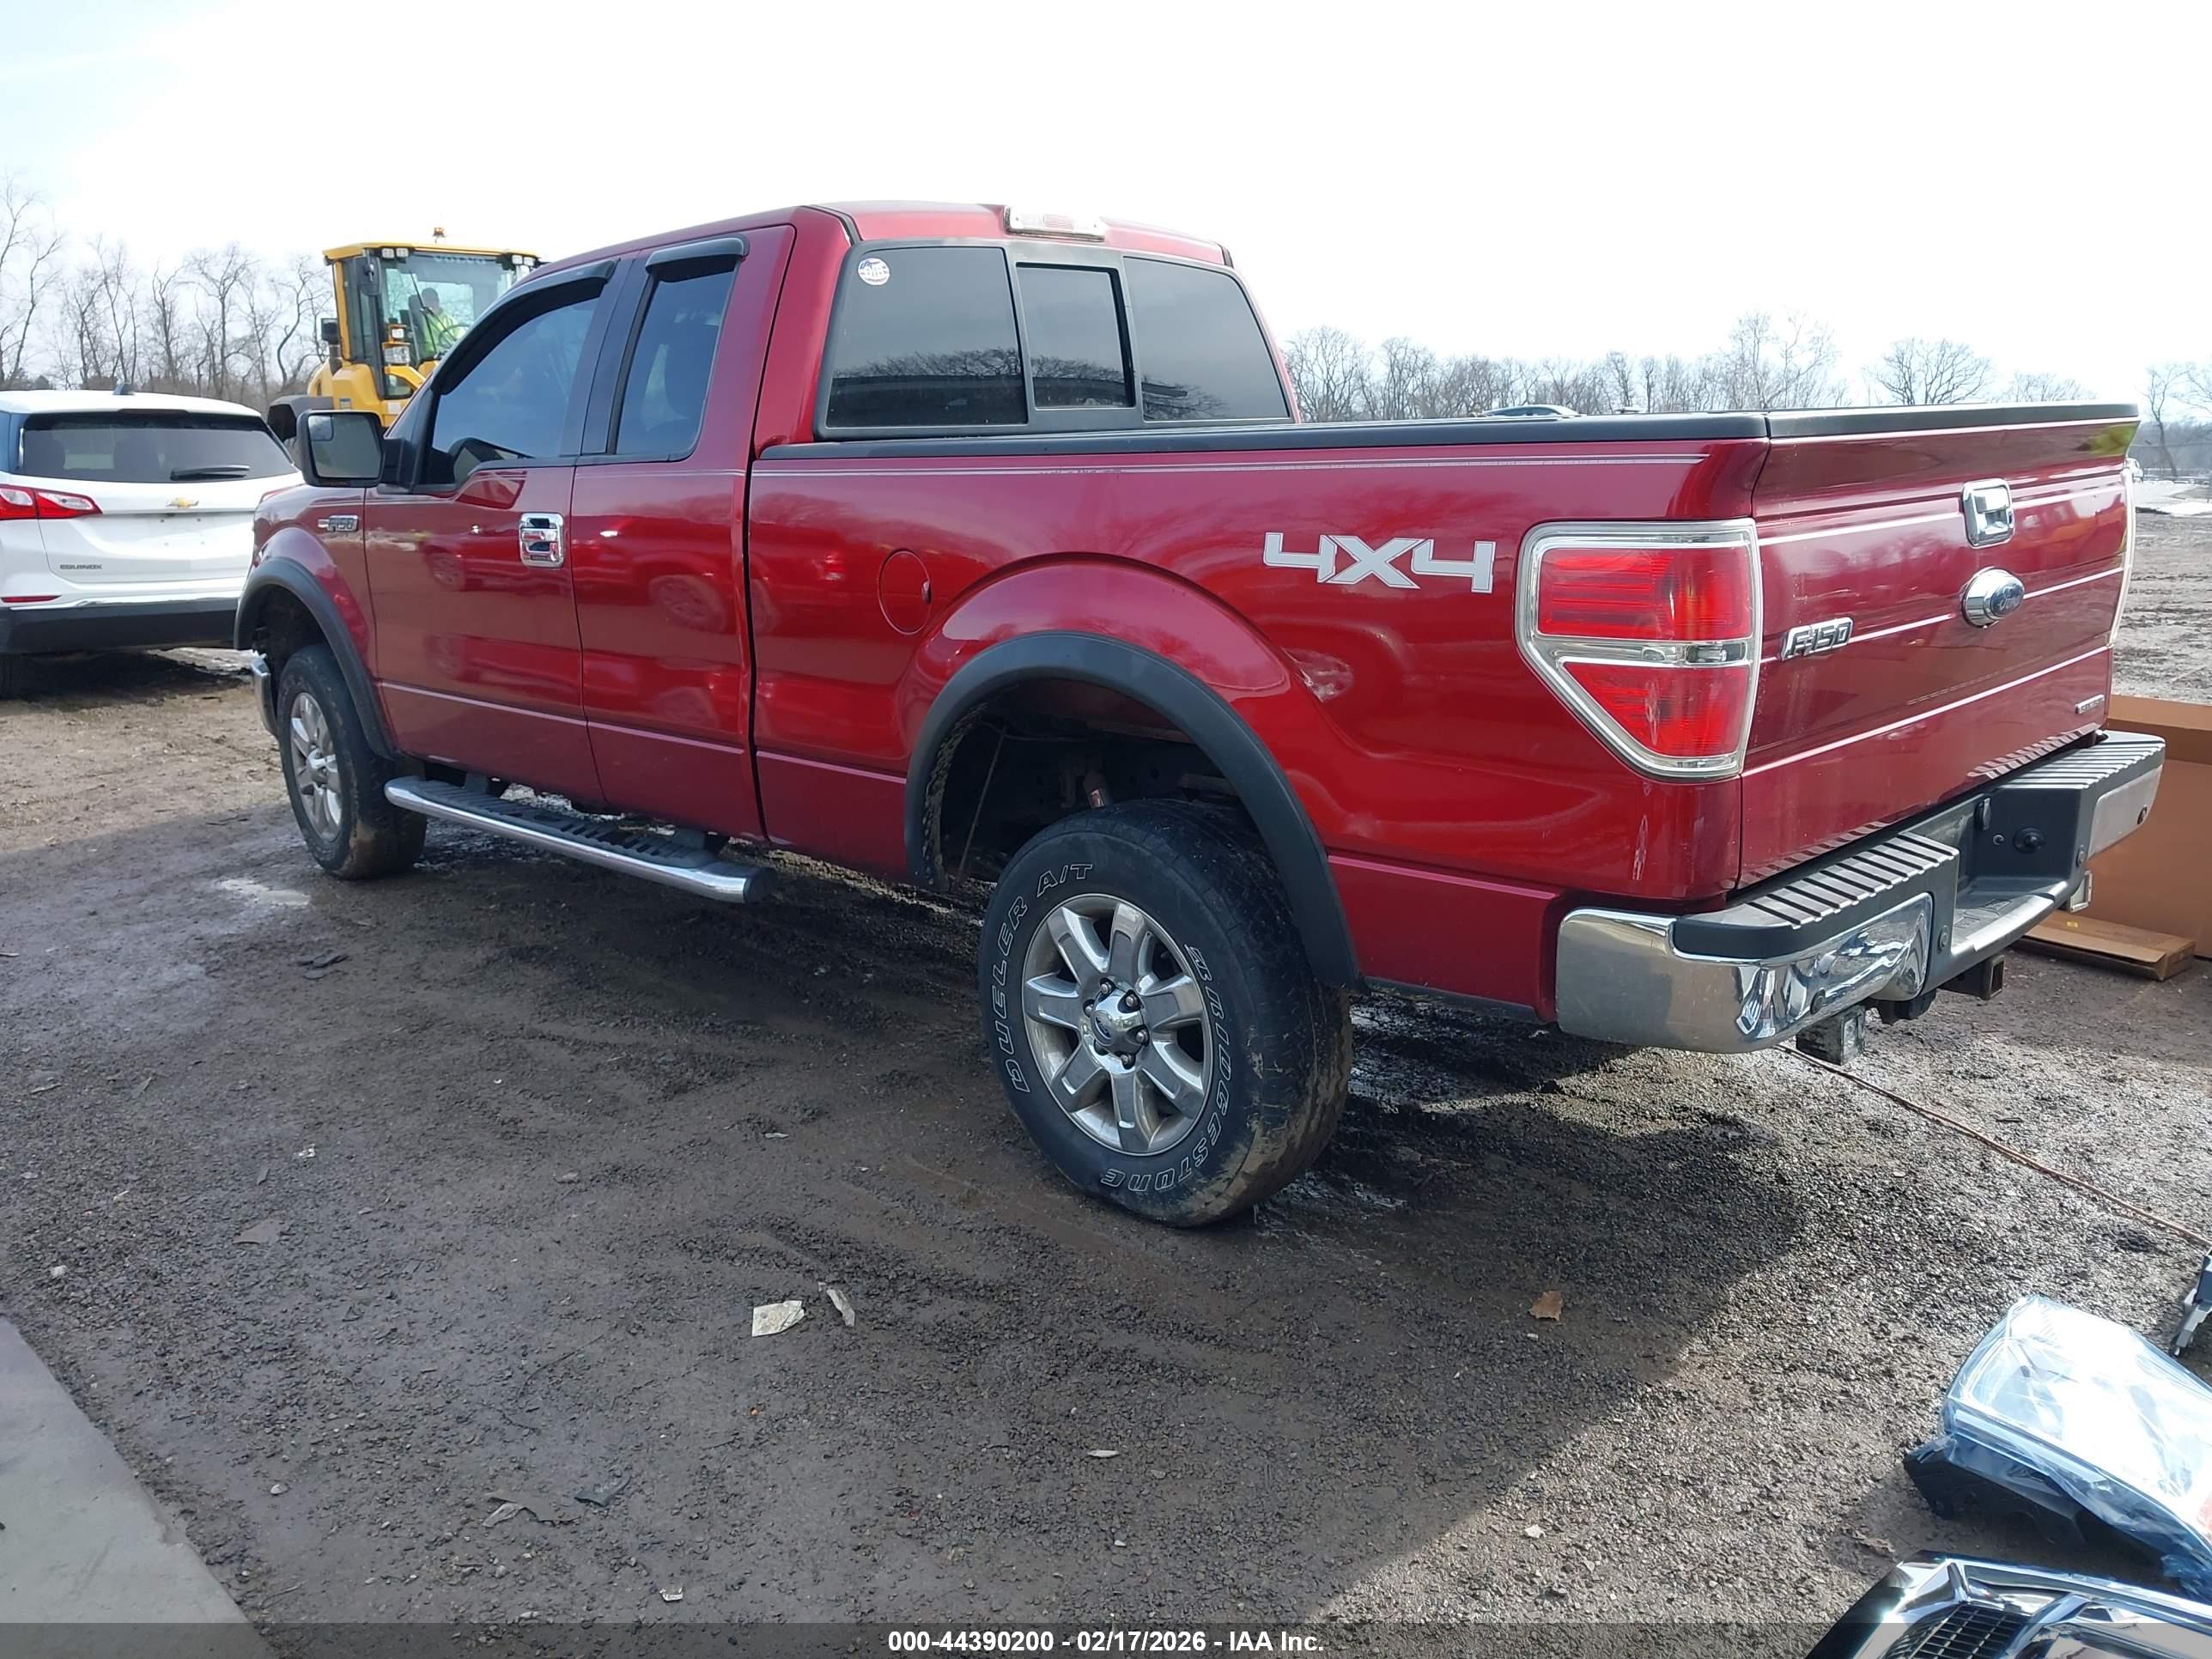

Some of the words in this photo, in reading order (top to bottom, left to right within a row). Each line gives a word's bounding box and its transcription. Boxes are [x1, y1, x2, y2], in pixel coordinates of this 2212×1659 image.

[1781, 617, 1853, 661] F-150
[992, 896, 1029, 1093] DUELER
[1036, 864, 1093, 897] A/T
[1100, 943, 1231, 1192] BRIDGESTONE
